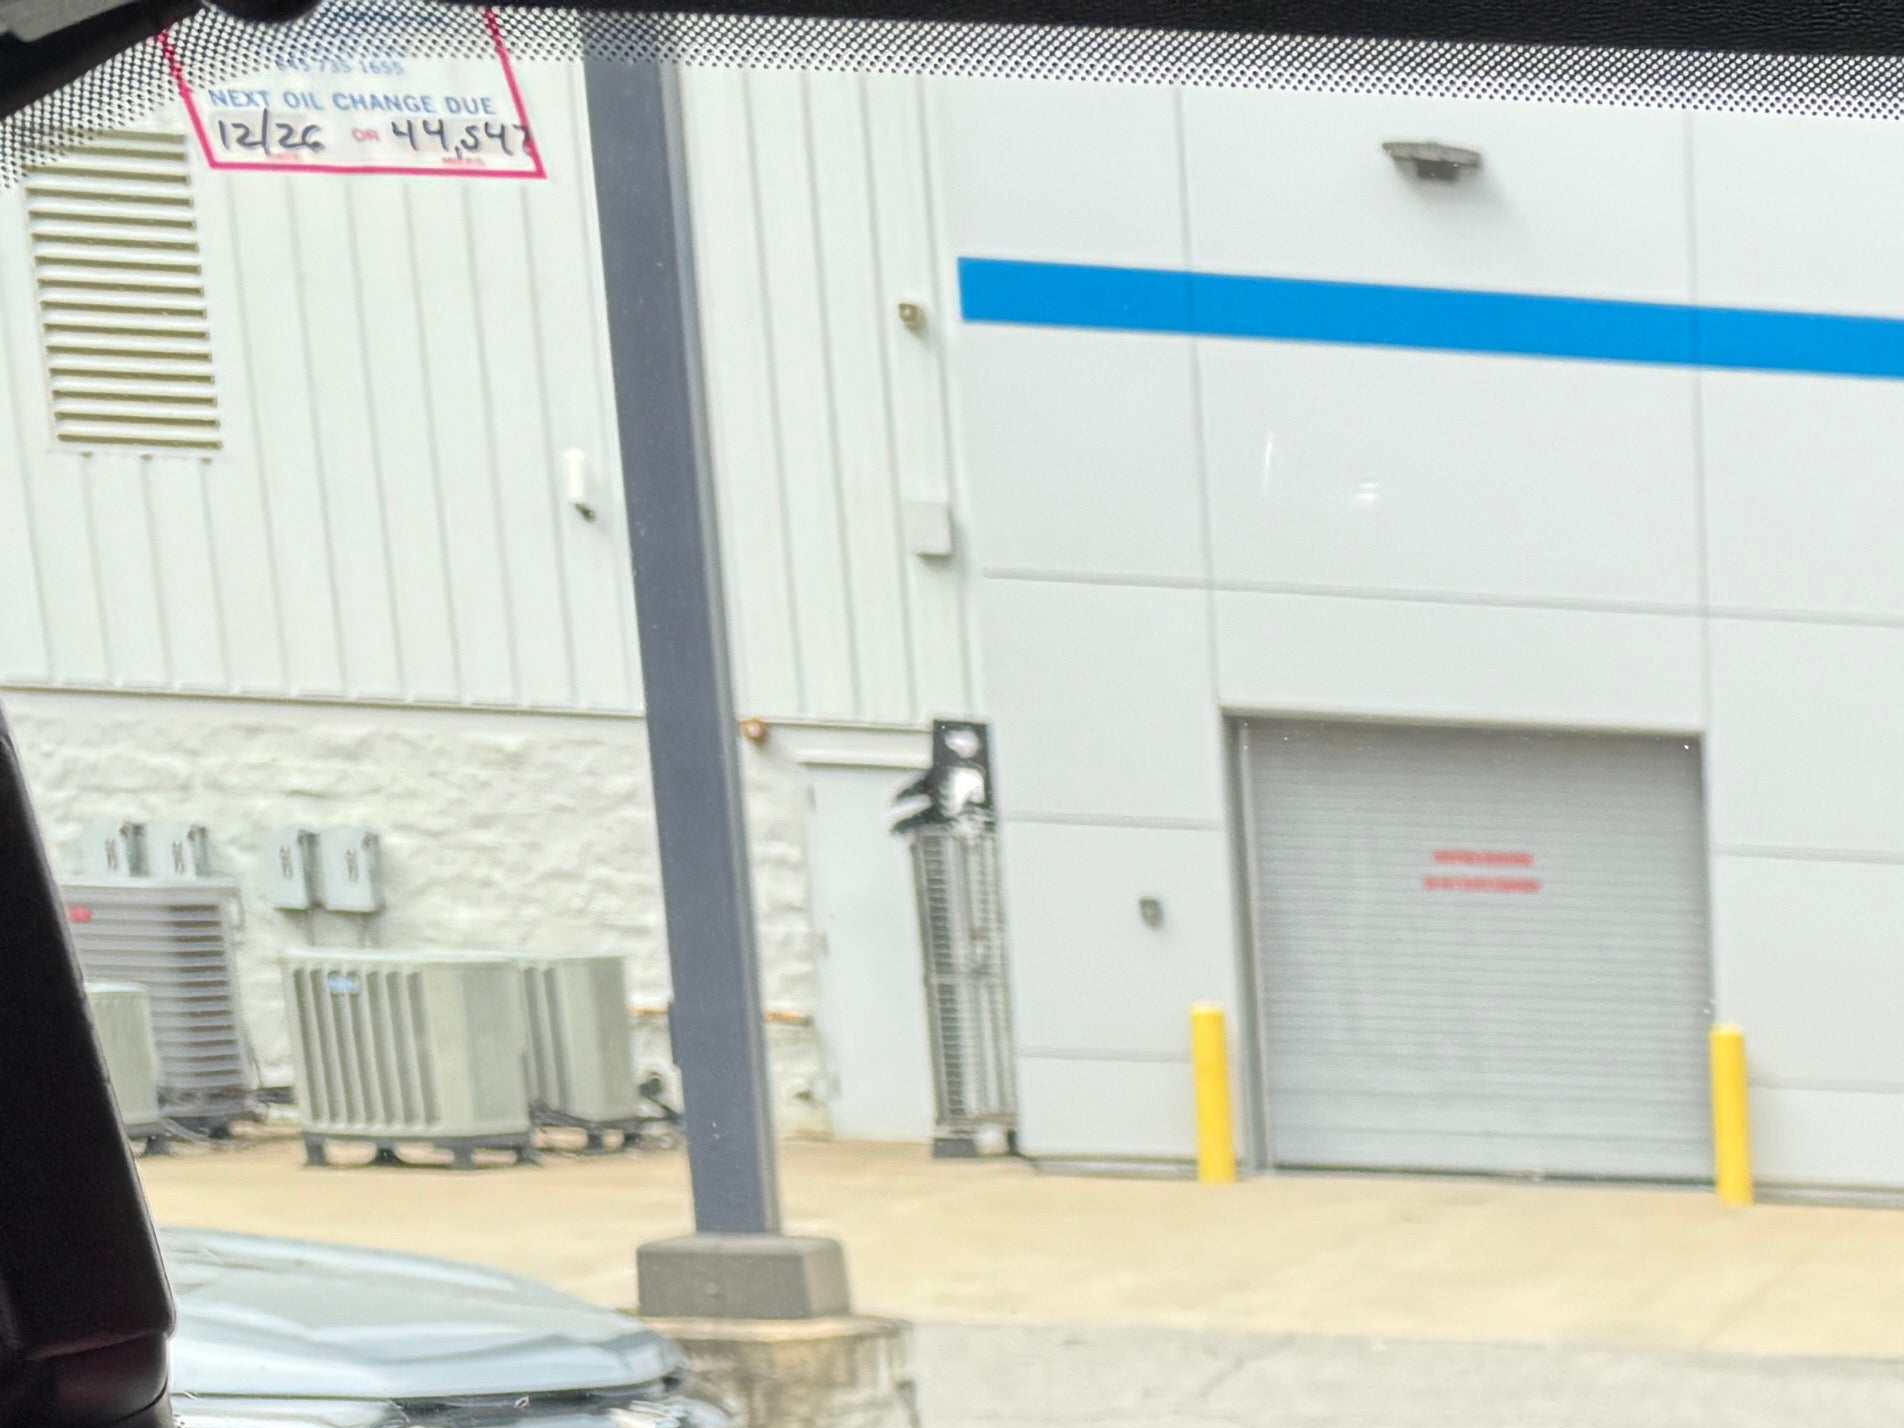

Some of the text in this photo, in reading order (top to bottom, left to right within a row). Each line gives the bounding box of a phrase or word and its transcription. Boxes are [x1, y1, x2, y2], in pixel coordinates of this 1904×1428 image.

[209, 90, 498, 115] NEXT OIL CHANGE DUE
[351, 128, 380, 143] OR
